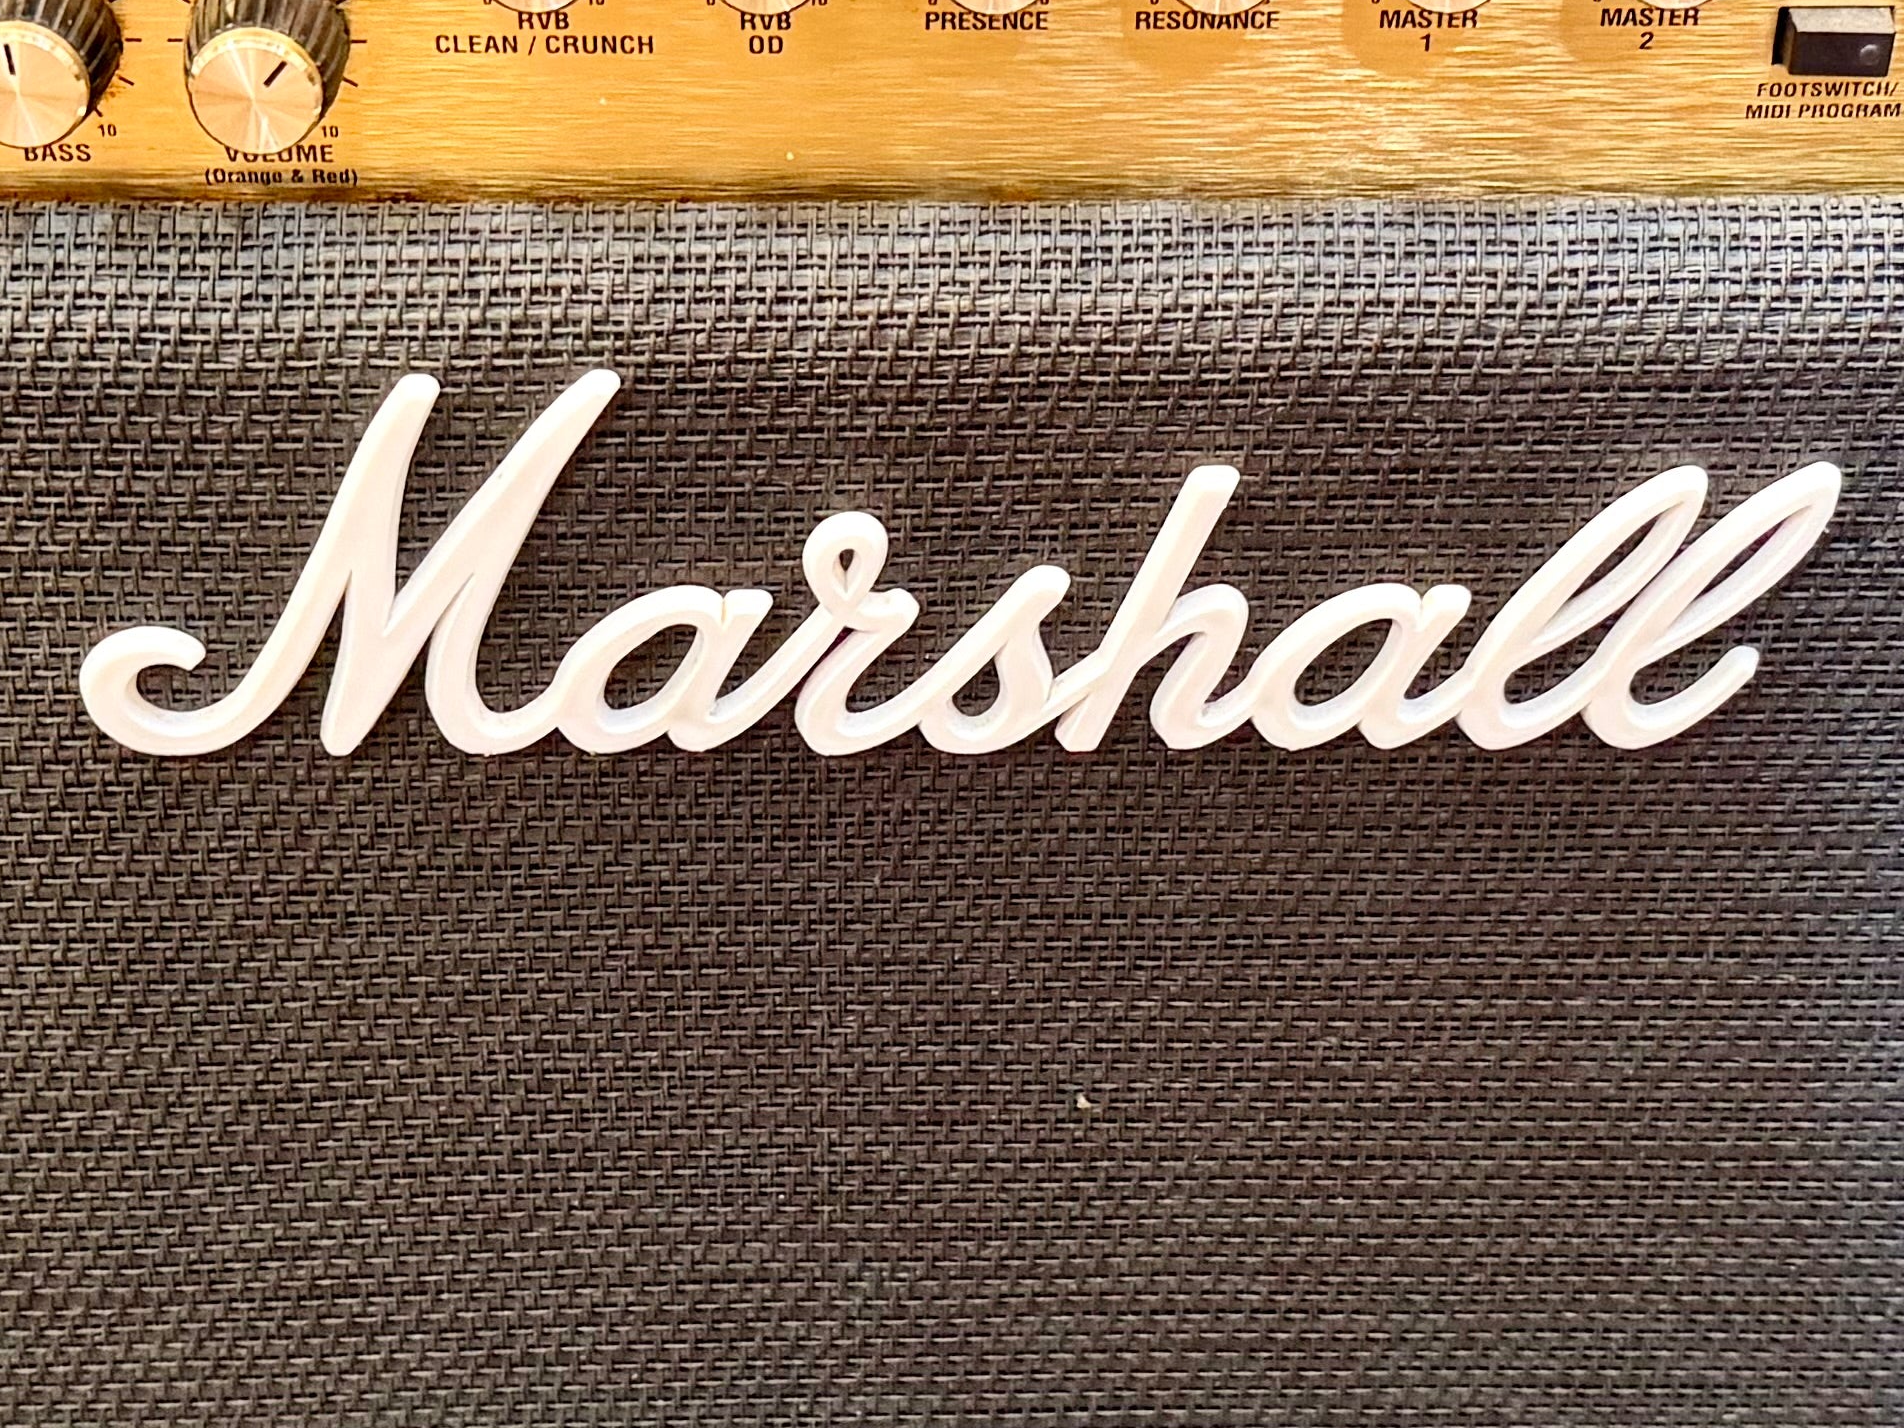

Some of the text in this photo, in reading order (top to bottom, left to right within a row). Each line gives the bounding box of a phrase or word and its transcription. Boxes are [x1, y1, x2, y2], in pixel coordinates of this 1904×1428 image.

[518, 12, 570, 30] RVB
[740, 12, 791, 30] RVB
[925, 11, 1049, 30] PRESENCE
[1135, 10, 1280, 30] RESONANCE
[1379, 9, 1478, 29] MASTER
[1600, 8, 1700, 27] MASTER
[435, 35, 518, 54] CLEAN
[545, 35, 654, 54] CRUNCH
[749, 36, 783, 54] OD
[1420, 34, 1431, 52] 1
[1639, 32, 1654, 50] 2
[1756, 81, 1899, 97] FOOTSWITCH/
[1746, 103, 1902, 119] MIDI PROGRAM
[98, 124, 117, 137] 10
[321, 125, 339, 138] 10
[24, 143, 91, 162] BASS
[204, 168, 358, 186] (Orange & Red)
[78, 369, 1844, 759] Marshall
